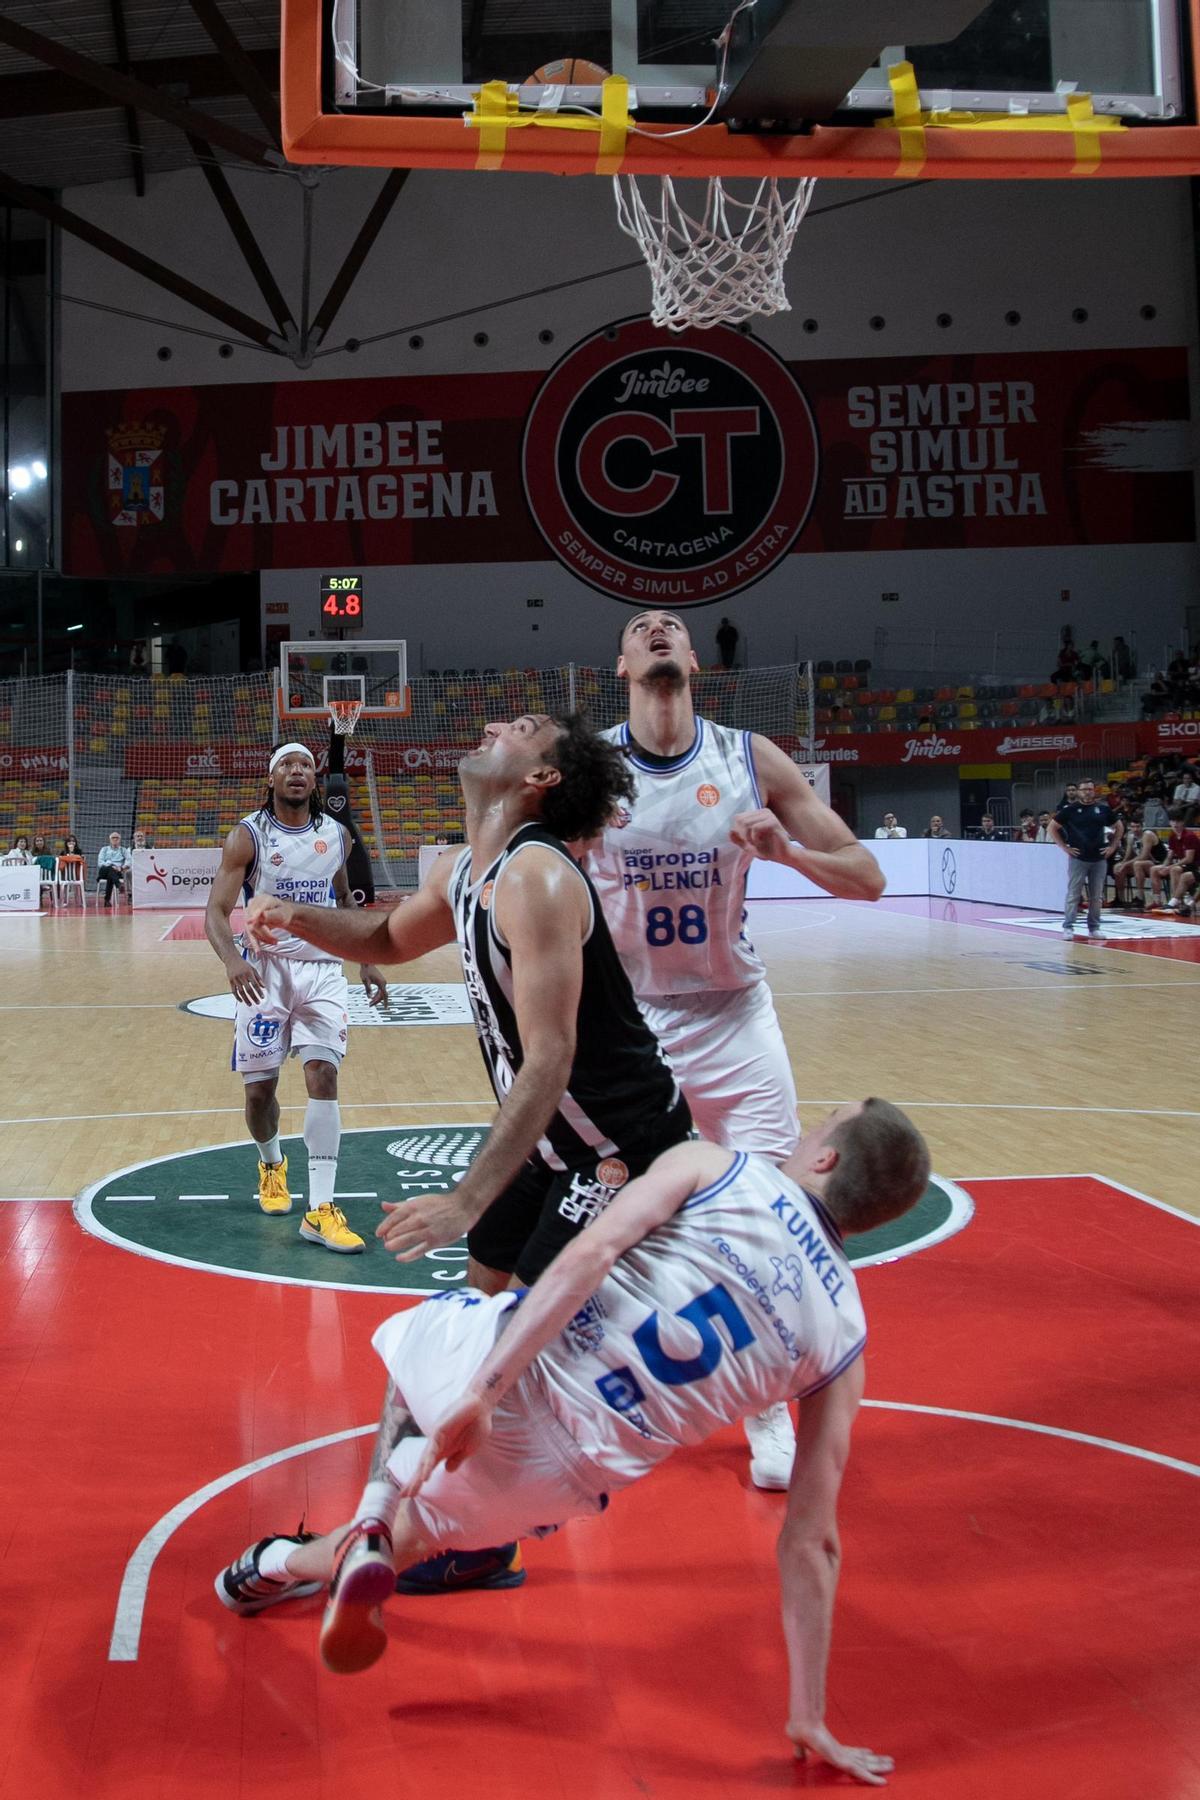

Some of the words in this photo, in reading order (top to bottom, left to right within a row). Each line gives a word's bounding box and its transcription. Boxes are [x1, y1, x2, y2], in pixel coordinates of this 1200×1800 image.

[614, 360, 710, 403] Jimbee
[847, 381, 1038, 429] SEMPER
[261, 420, 443, 471] JIMBEE
[576, 406, 760, 517] CT
[869, 428, 1018, 474] SIMUL
[209, 471, 499, 525] CARTAGENA
[844, 483, 887, 515] AD
[895, 473, 1047, 518] ASTRA
[558, 530, 627, 587] SEMPER
[632, 576, 695, 595] SIMUL
[702, 570, 729, 590] AD
[733, 522, 789, 577] ASTRA
[613, 525, 735, 557] CARTAGENA
[323, 594, 361, 616] 4.8
[329, 578, 358, 589] 5:07
[901, 733, 961, 762] Jimbee
[1157, 722, 1200, 736] SKO
[625, 848, 719, 870] agropal
[171, 875, 215, 891] Depor
[276, 878, 328, 891] agropal
[646, 904, 708, 947] 88
[769, 1193, 845, 1307] KUNKEL
[632, 1282, 756, 1386] 5
